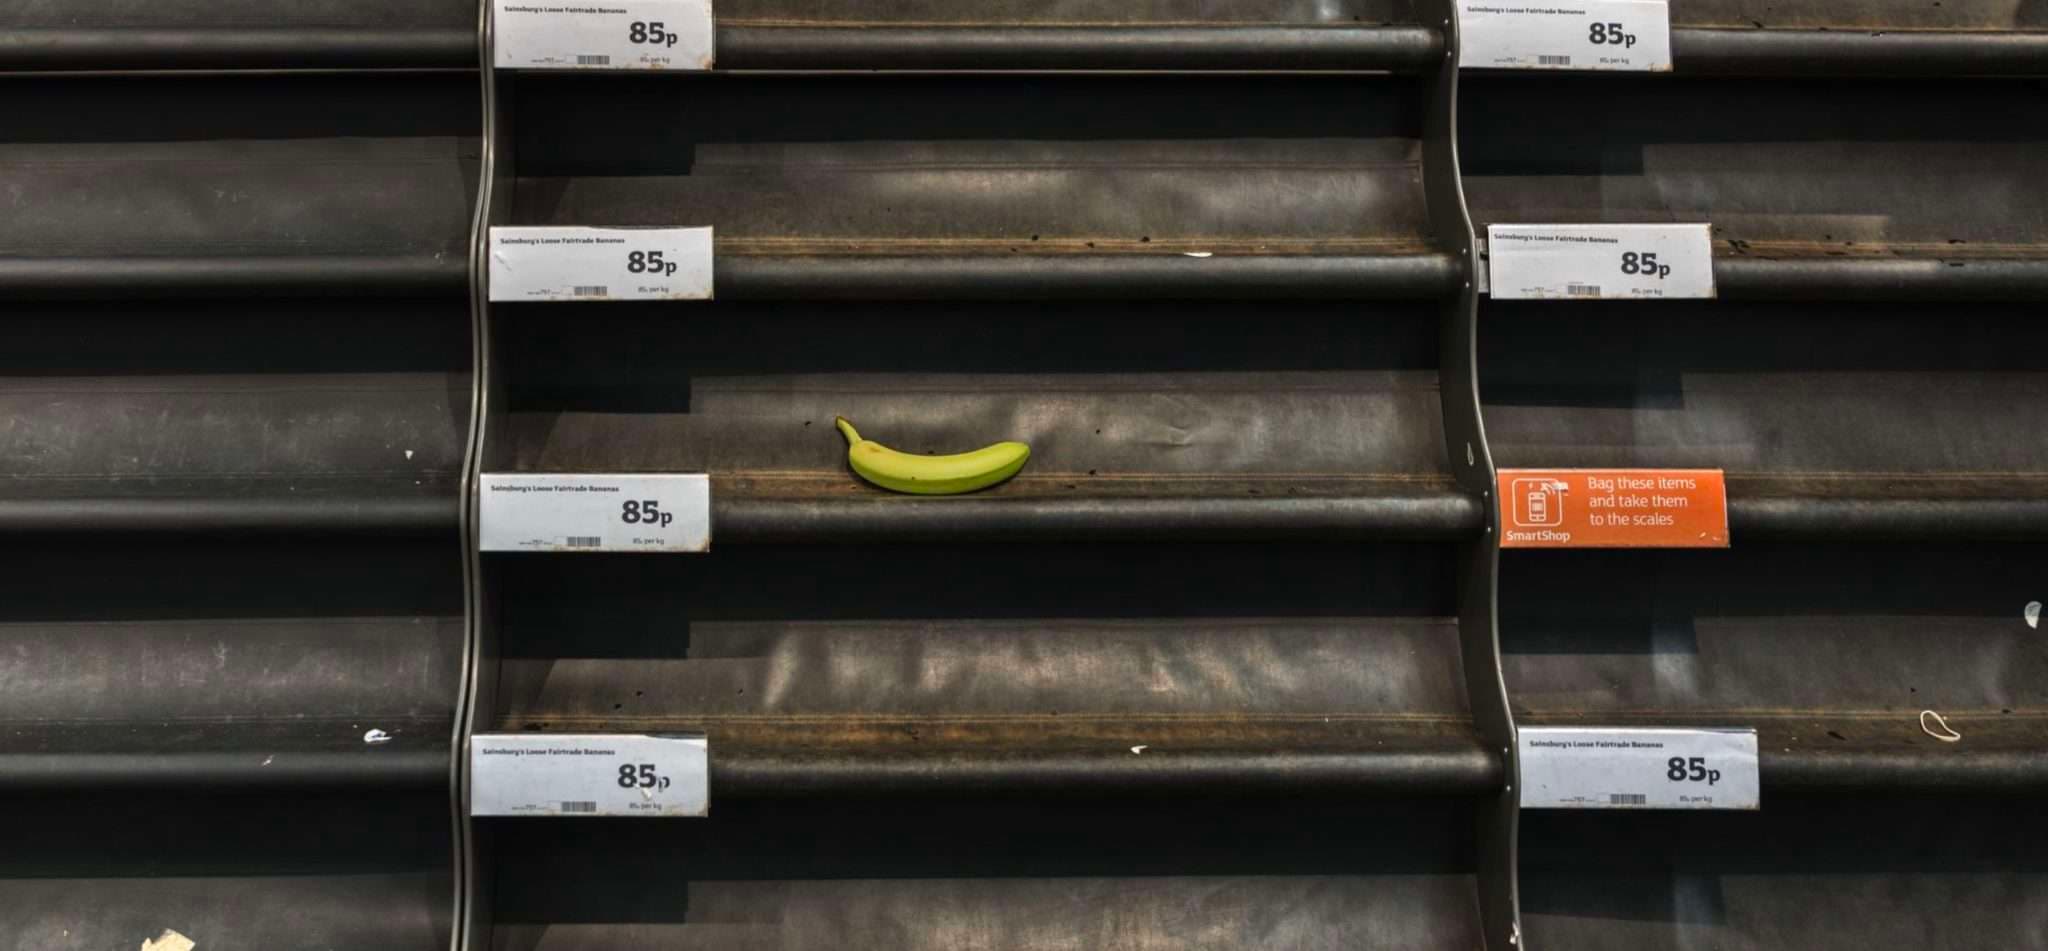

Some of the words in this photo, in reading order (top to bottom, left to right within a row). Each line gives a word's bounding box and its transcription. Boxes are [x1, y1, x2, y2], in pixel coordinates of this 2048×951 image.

[629, 21, 678, 48] 85p
[1588, 22, 1636, 48] 85p
[1555, 235, 1587, 243] Fairtrade
[627, 251, 677, 276] 85p
[1621, 252, 1671, 279] 85p
[1588, 477, 1614, 493] Bag
[1617, 477, 1655, 489] these
[1658, 476, 1696, 489] items
[622, 500, 673, 527] 85p
[1589, 495, 1616, 508] and
[1619, 495, 1650, 508] take
[1652, 495, 1688, 508] them
[1590, 514, 1604, 526] to
[1607, 513, 1630, 526] the
[1633, 513, 1674, 526] scales
[1506, 531, 1570, 543] SmartShop
[617, 764, 670, 792] 85p
[1667, 757, 1720, 785] 85p
